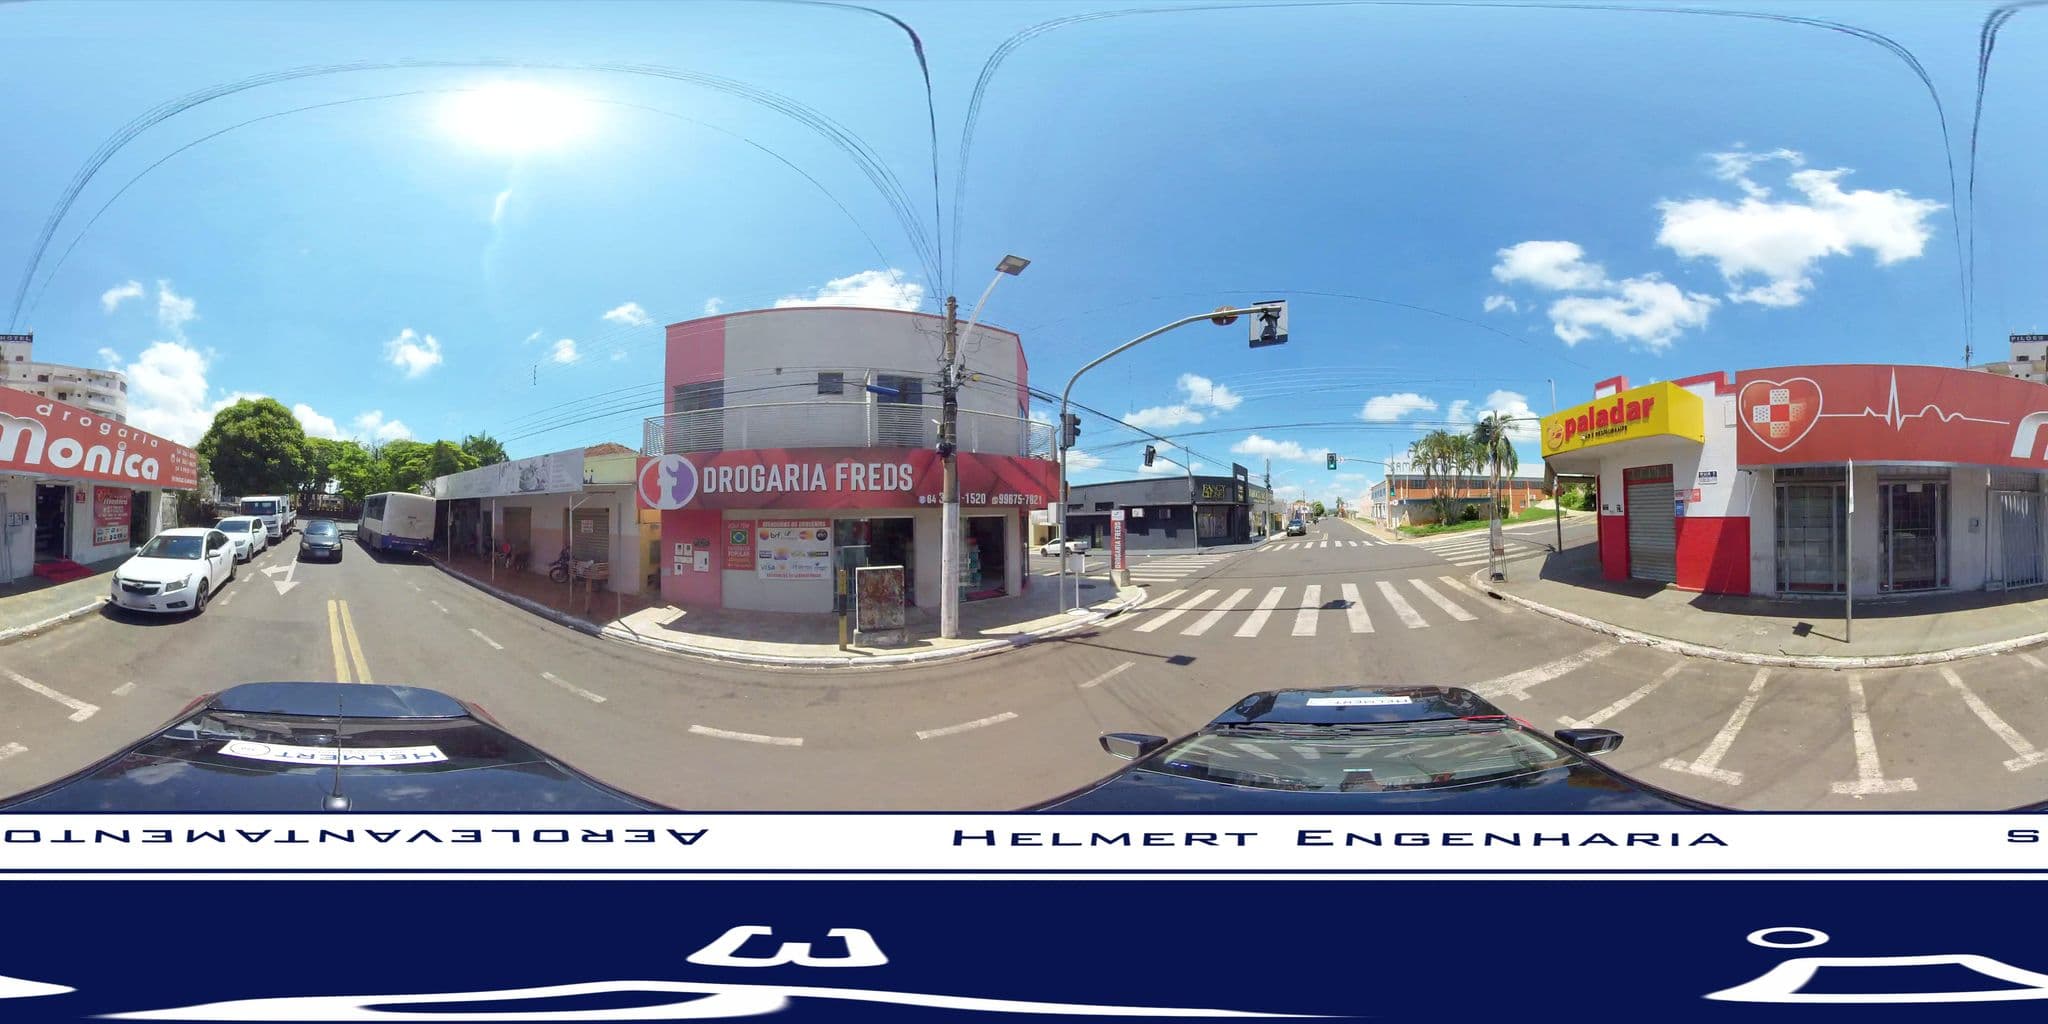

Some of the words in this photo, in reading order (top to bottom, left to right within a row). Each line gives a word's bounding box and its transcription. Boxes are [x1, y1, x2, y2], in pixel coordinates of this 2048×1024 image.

[36, 403, 158, 448] drogaria
[1564, 396, 1655, 442] paladar
[703, 463, 828, 493] DROGARIA
[835, 463, 913, 492] FREDS
[276, 751, 438, 761] HELMERT
